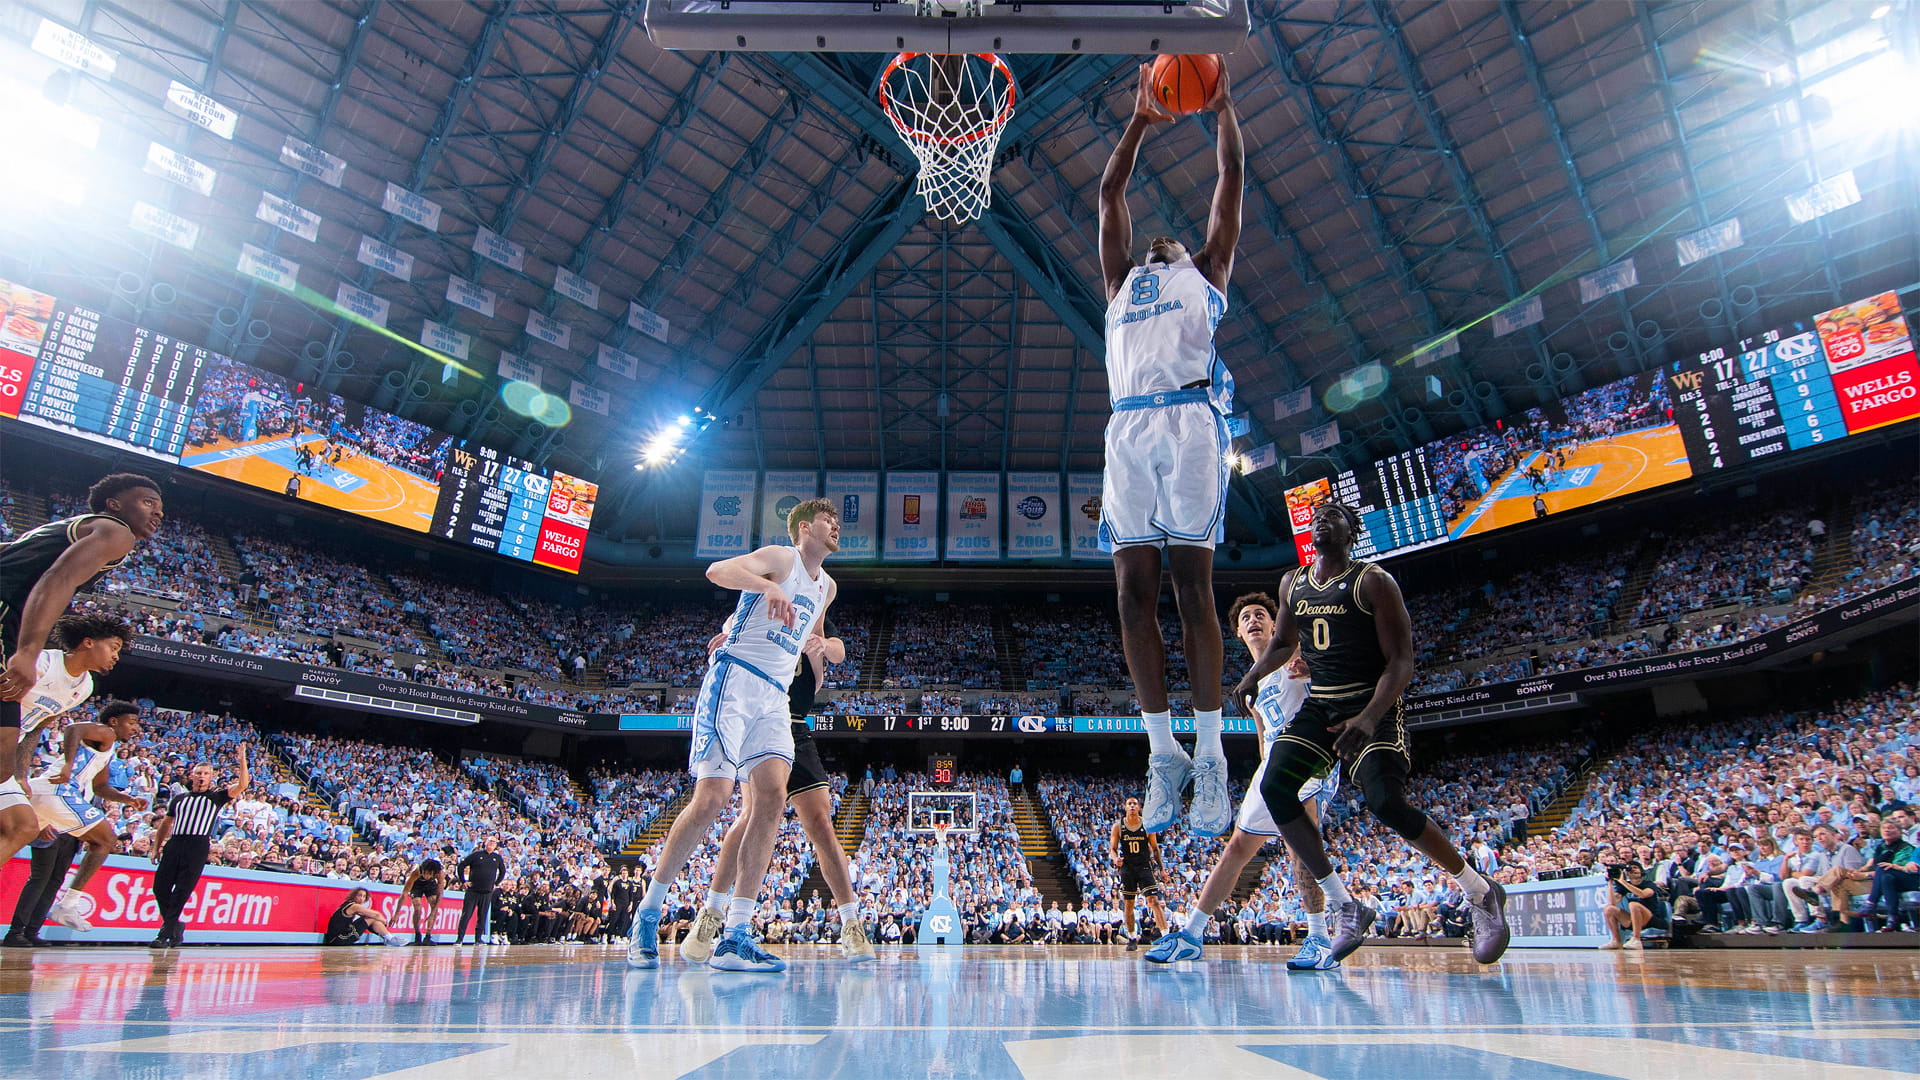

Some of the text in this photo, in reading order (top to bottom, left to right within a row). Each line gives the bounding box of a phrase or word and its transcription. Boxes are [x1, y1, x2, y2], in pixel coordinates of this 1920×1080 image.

[188, 109, 213, 127] 1957
[204, 104, 226, 121] FOUR
[1132, 273, 1160, 306] 8
[74, 306, 100, 321] PLAYER
[68, 315, 98, 332] BILIEW
[64, 325, 96, 342] COLVIN
[58, 344, 86, 360] AKINS
[61, 334, 94, 352] MASON
[1699, 330, 1780, 364] 9:00 30
[1832, 344, 1862, 359] 2GO
[52, 365, 80, 381] EVANS
[54, 355, 104, 378] SCHWIEGER
[1670, 347, 1769, 391] WF 17 27
[49, 375, 78, 391] YOUNG
[1696, 368, 1808, 411] 5 11
[1844, 370, 1912, 398] WELLS
[46, 385, 80, 403] WILSON
[1850, 385, 1917, 413] FARGO
[41, 395, 75, 413] POWELL
[1699, 384, 1810, 426] 2 9
[39, 405, 76, 425] VEESAAR
[1703, 399, 1815, 440] 6 4
[1708, 415, 1819, 455] 2 6
[1713, 430, 1823, 469] 4 5
[1751, 442, 1784, 458] ASSISTS
[454, 449, 522, 485] WF 17 27
[480, 446, 533, 472] 9:00 30
[459, 479, 533, 510] 5 11
[456, 490, 529, 521] 2 9
[453, 503, 525, 533] 6 4
[449, 516, 523, 545] 2 6
[545, 530, 580, 547] WELLS
[445, 528, 520, 556] 4 5
[542, 541, 578, 558] FARGO
[707, 535, 743, 546] 1924
[895, 536, 928, 548] 1993
[956, 536, 990, 548] 2005
[1015, 535, 1054, 547] 2009
[1078, 535, 1098, 549] 20
[1872, 593, 1897, 608] Hotel
[1898, 587, 1920, 600] Bran
[1295, 599, 1348, 616] Deacons
[1312, 618, 1330, 651] 0
[1785, 624, 1820, 642] BONVOY
[163, 645, 178, 657] for
[180, 649, 207, 663] Every
[209, 654, 233, 666] Kind
[235, 658, 245, 668] of
[246, 660, 263, 671] Fan
[1584, 672, 1607, 684] Over
[1607, 670, 1617, 680] 30
[1619, 666, 1644, 678] Hotel
[1645, 660, 1677, 674] Brands
[1678, 656, 1692, 668] for
[1693, 652, 1722, 667] Every
[1723, 647, 1745, 662] Kind
[1753, 641, 1768, 655] Fan
[301, 673, 342, 686] BONVOY
[1516, 683, 1554, 696] BONVOY
[378, 683, 528, 715] Over 30 Hotel Brands for Every Kind of Fan
[1414, 701, 1424, 710] for
[1425, 697, 1445, 710] Every
[1446, 694, 1466, 705] Kind
[1466, 692, 1474, 702] of
[1475, 691, 1490, 701] Fan
[558, 715, 588, 726] BONVOY
[1263, 699, 1284, 727] 0
[845, 715, 1005, 731] WF 17 1ST 9:00 27
[1088, 719, 1147, 731] CAROLIN
[936, 760, 953, 769] 8:59
[935, 769, 951, 783] 30
[1129, 841, 1140, 854] 10
[100, 873, 272, 925] Stae Farm
[1515, 895, 1523, 911] 17
[1547, 892, 1565, 909] 9:00
[1578, 889, 1590, 908] 27
